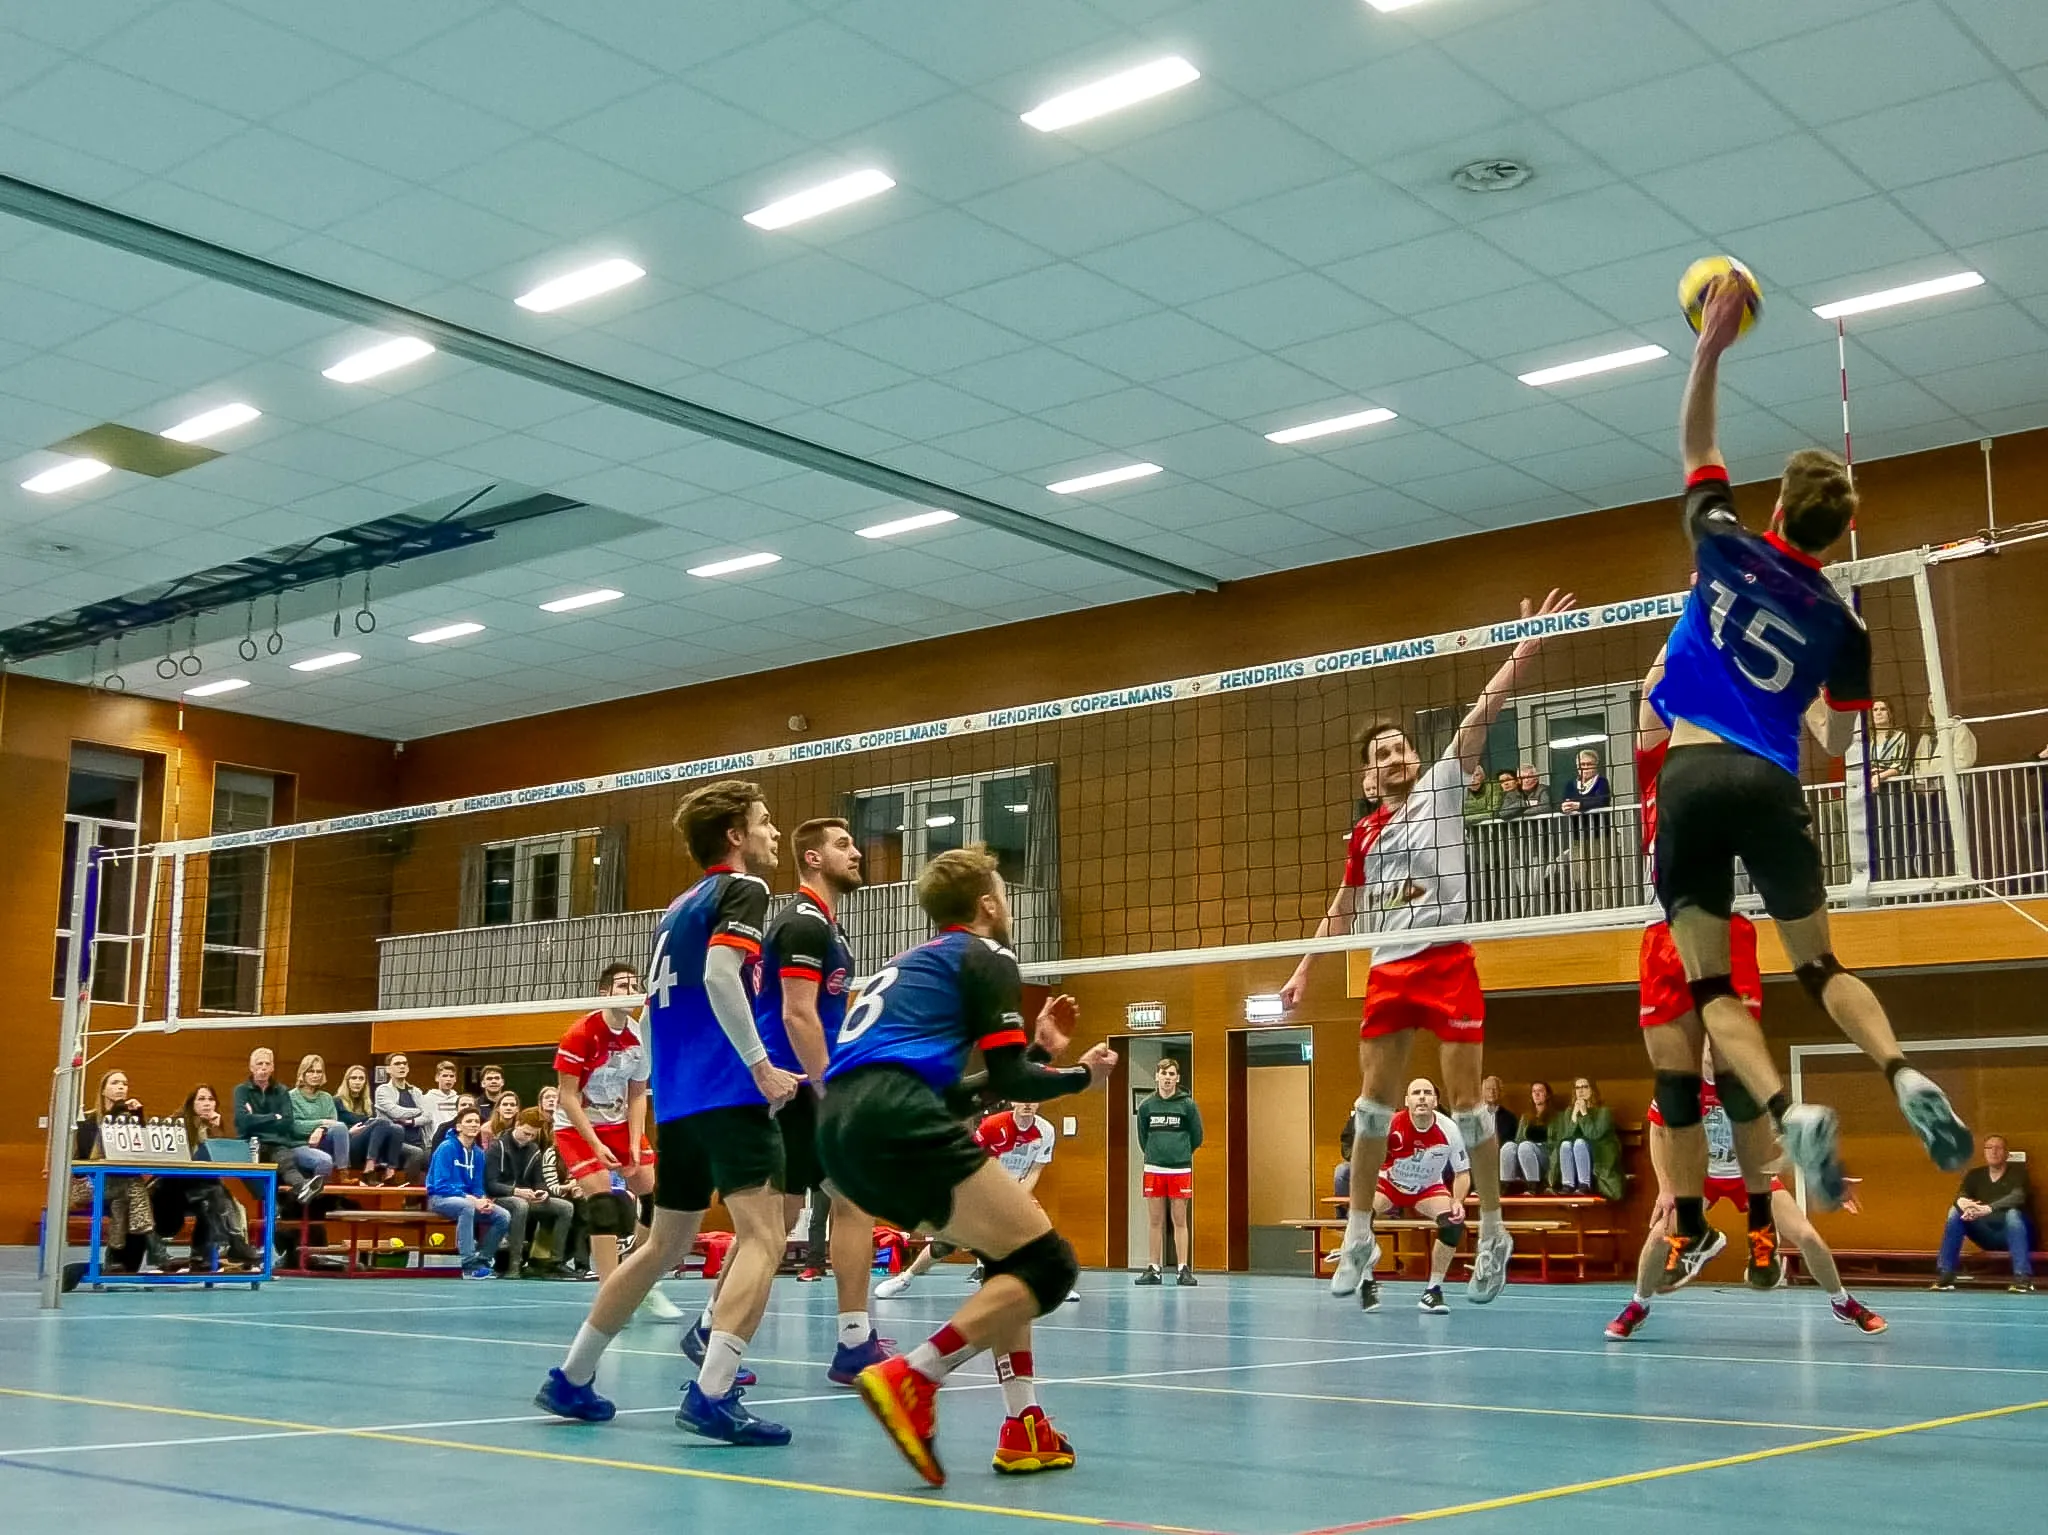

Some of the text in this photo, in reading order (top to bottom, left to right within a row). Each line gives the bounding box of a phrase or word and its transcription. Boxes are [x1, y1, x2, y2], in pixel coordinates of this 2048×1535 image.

[1490, 612, 1590, 643] HENDRIKS
[1709, 579, 1807, 694] 15
[1219, 638, 1435, 690] HENDRIKS COPPELMANS
[987, 684, 1174, 728] HENDRIKS COPPELMANS
[789, 721, 948, 761] HENDRIKS COPPELMANS
[615, 753, 755, 788] HENDRIKS COPPELMANS
[463, 781, 586, 811] HENDRIKS COPPELMANS
[648, 929, 678, 1009] 4
[836, 966, 899, 1044] 8
